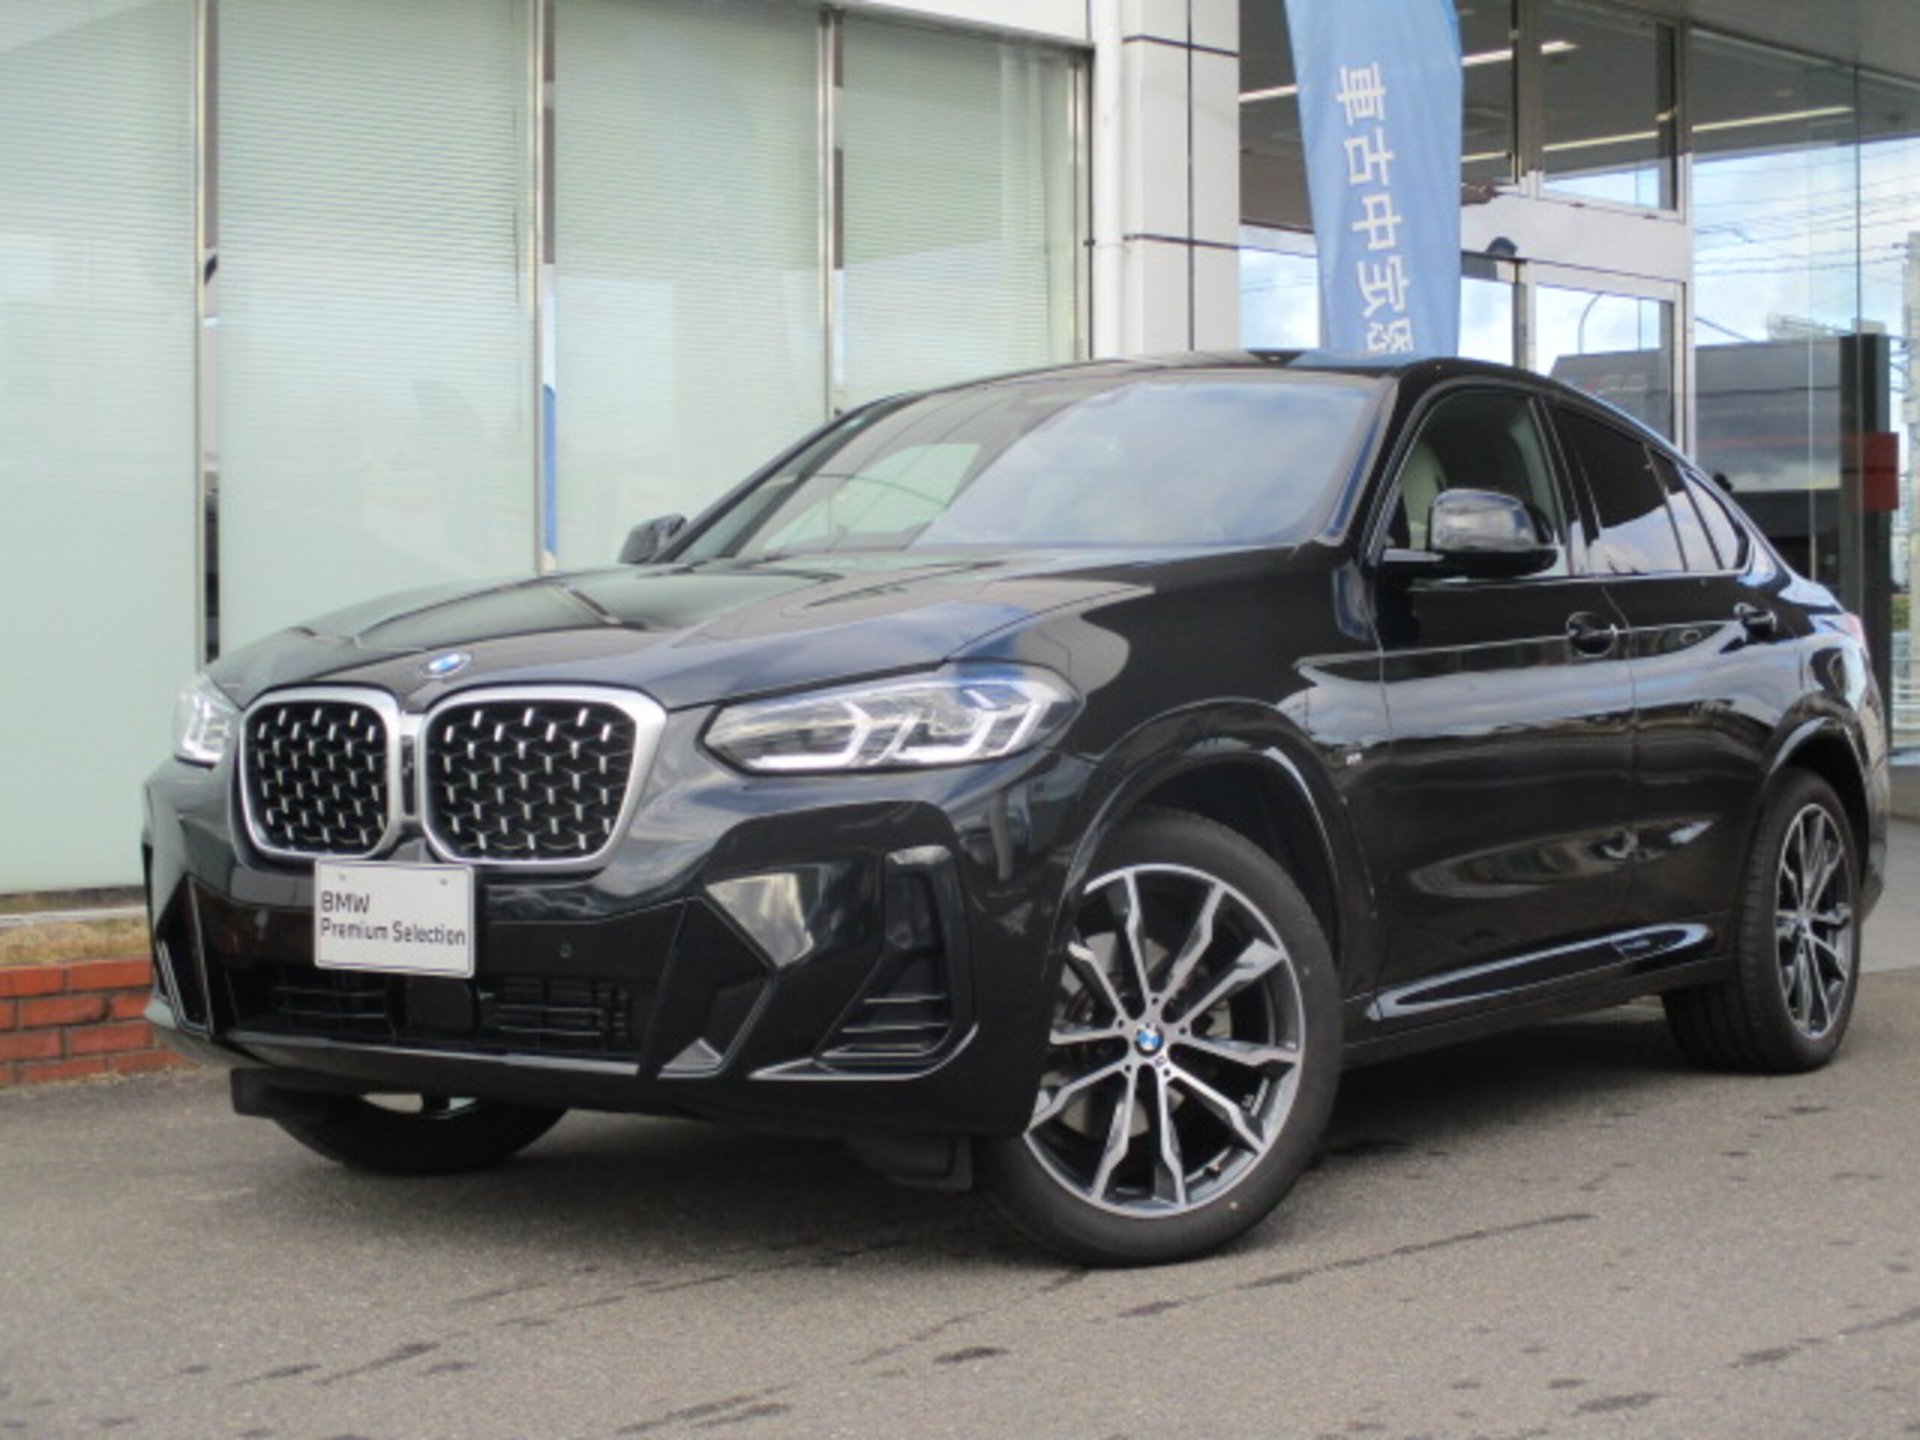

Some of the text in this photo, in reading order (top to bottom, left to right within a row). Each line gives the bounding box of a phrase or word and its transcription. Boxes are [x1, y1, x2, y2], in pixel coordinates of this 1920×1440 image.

[320, 890, 370, 914] BMW
[320, 917, 466, 946] Premium Selection
